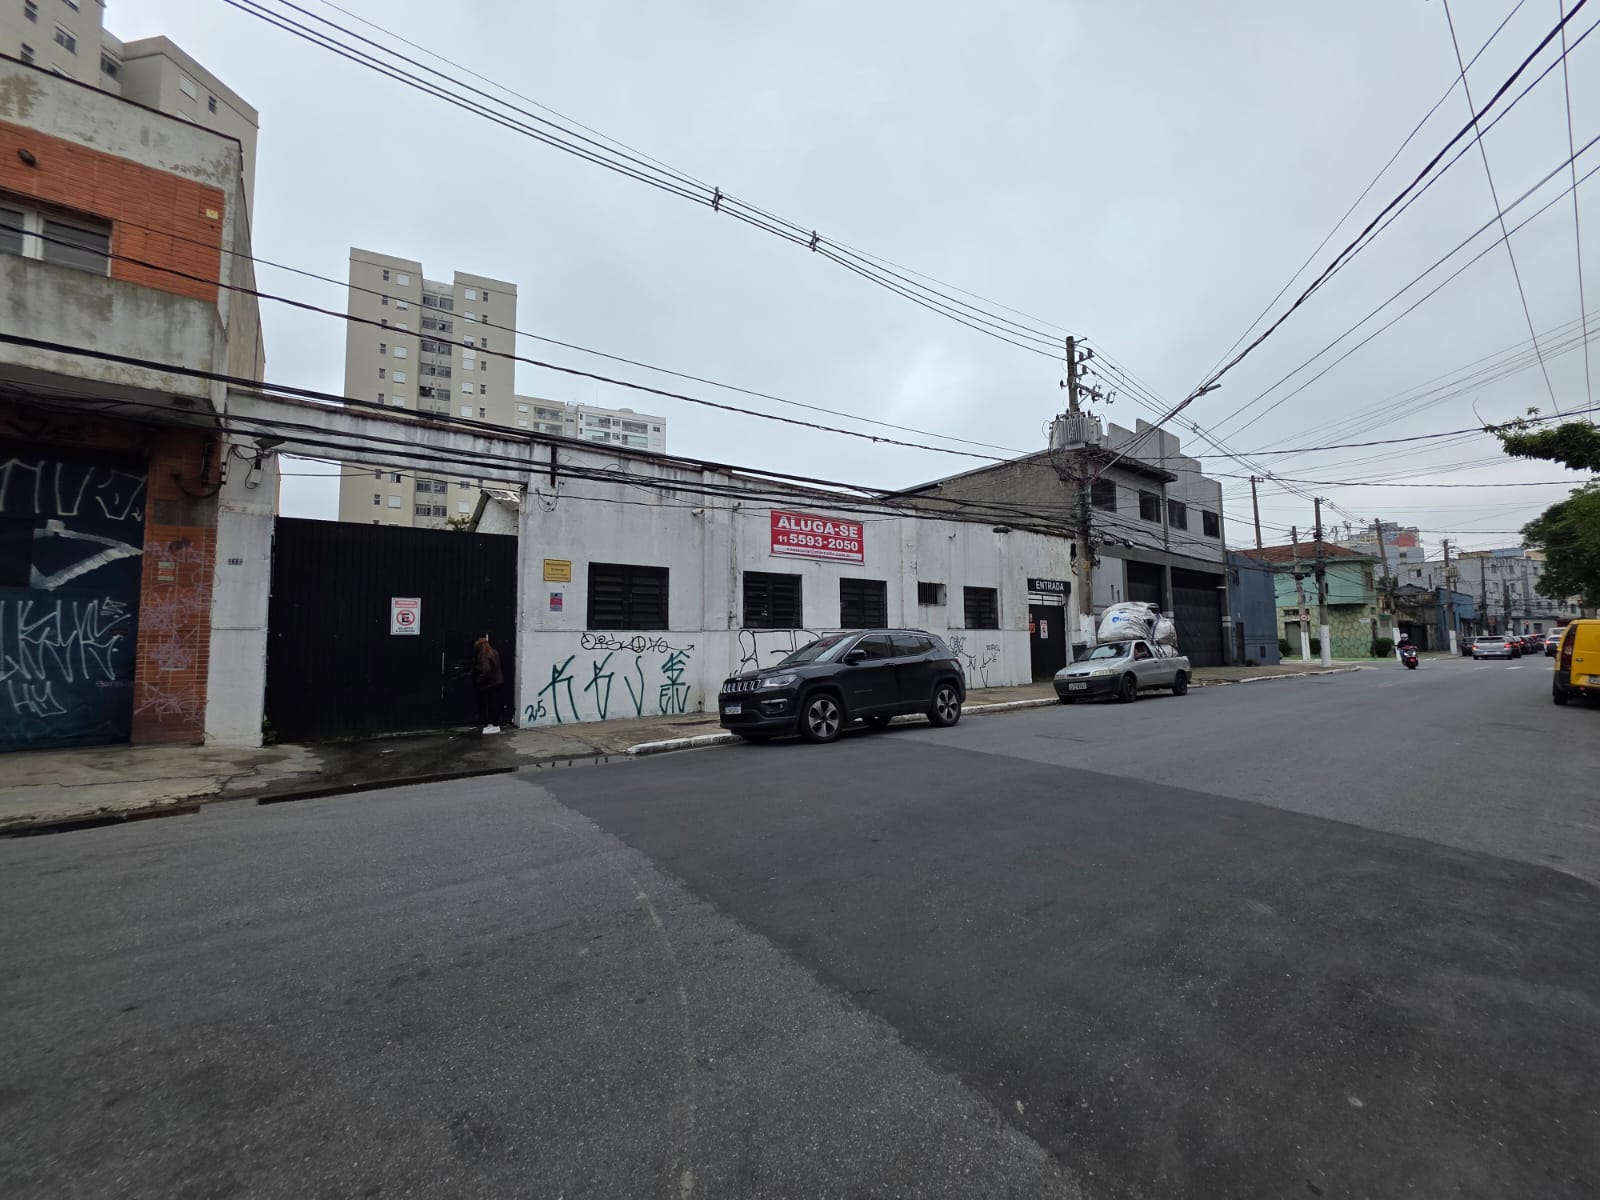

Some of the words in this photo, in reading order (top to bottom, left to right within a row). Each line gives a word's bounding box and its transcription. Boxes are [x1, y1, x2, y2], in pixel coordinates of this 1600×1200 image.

[777, 516, 858, 538] ALUGA-SE
[778, 535, 787, 543] 11
[789, 533, 858, 551] 5593-2050
[1035, 580, 1064, 591] ENTRADA
